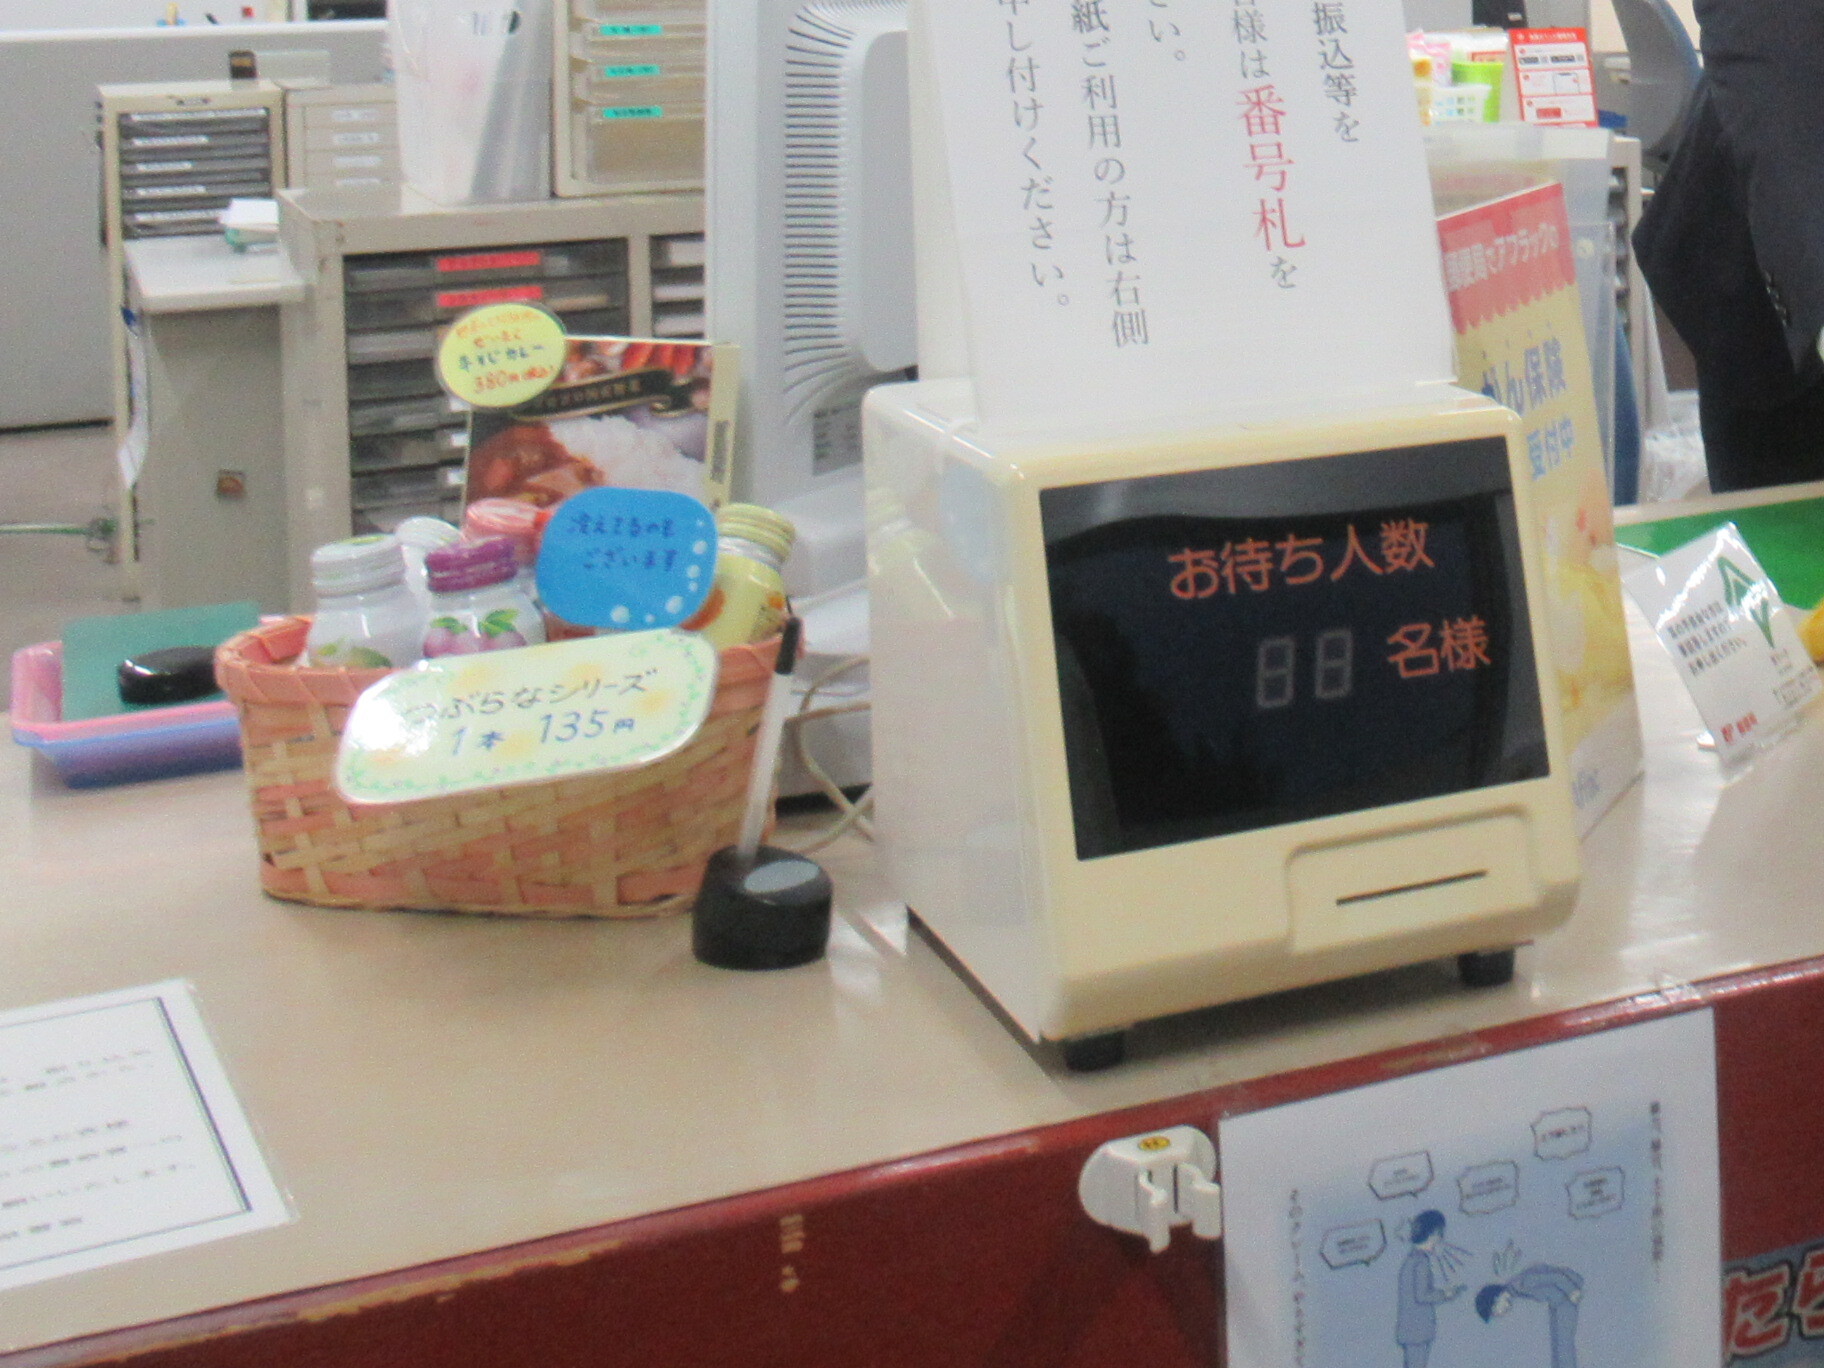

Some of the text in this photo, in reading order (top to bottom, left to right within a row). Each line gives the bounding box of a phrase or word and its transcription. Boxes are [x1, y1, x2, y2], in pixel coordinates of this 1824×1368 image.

[1526, 412, 1575, 482] 受付中
[1167, 518, 1435, 600] お待ち人数
[1387, 617, 1493, 679] 名様
[539, 708, 636, 744] 135円
